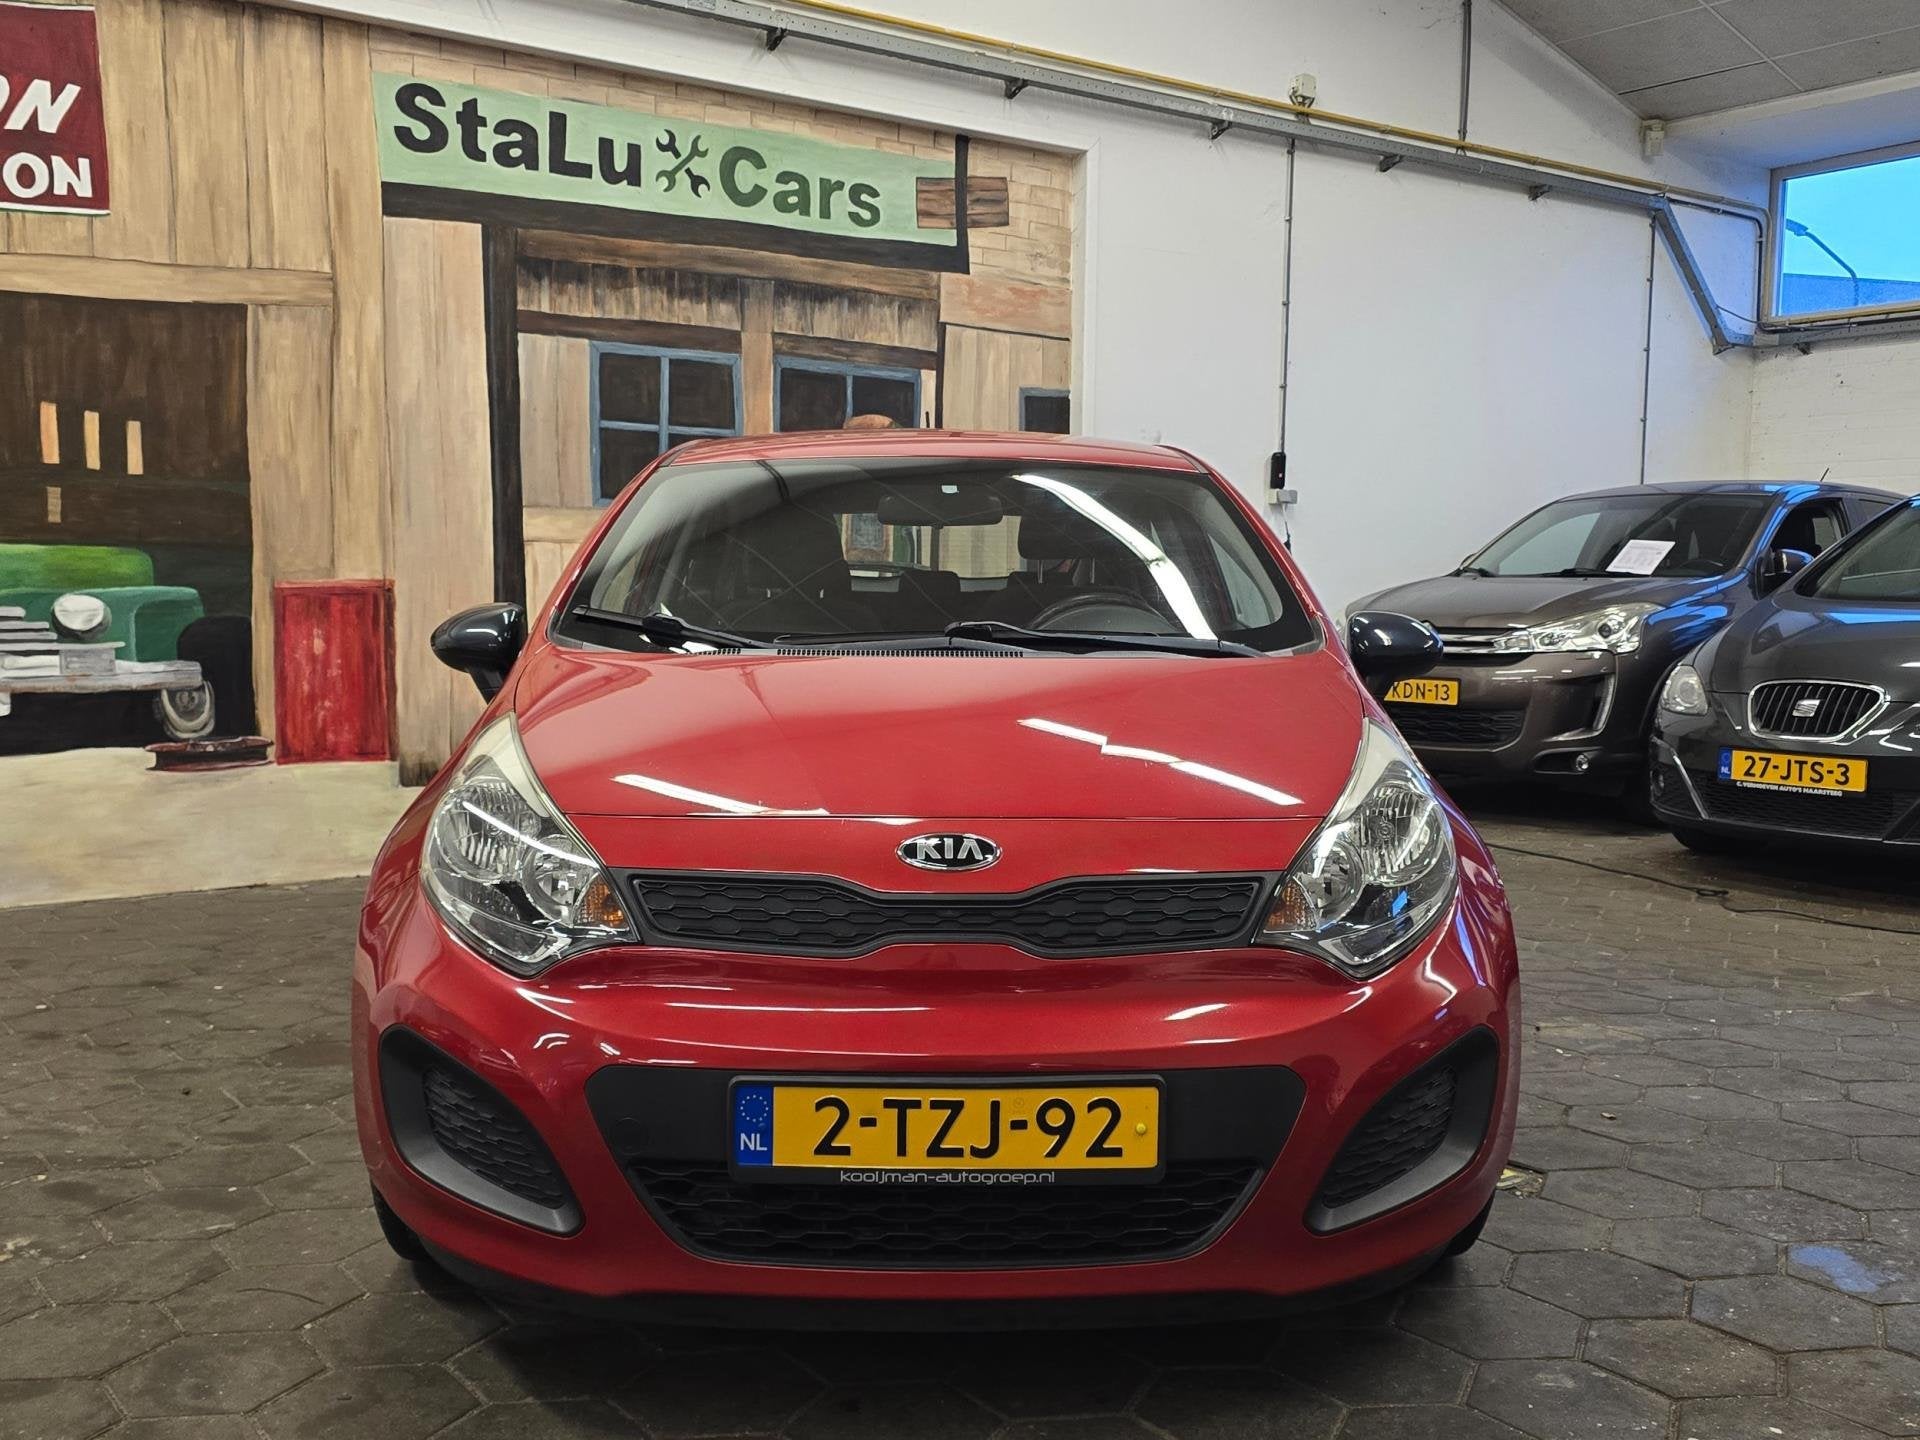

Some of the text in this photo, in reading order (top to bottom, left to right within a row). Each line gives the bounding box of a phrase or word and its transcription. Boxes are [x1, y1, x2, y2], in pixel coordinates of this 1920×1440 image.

[393, 82, 882, 229] StaLu Cars
[1720, 765, 1731, 775] NL
[1743, 755, 1850, 786] 27-JTS-3
[916, 838, 984, 860] KIA
[813, 1096, 1123, 1159] 2-TZJ-92
[740, 1133, 768, 1152] NL
[840, 1170, 1056, 1185] kooijman-autogroep.nl
